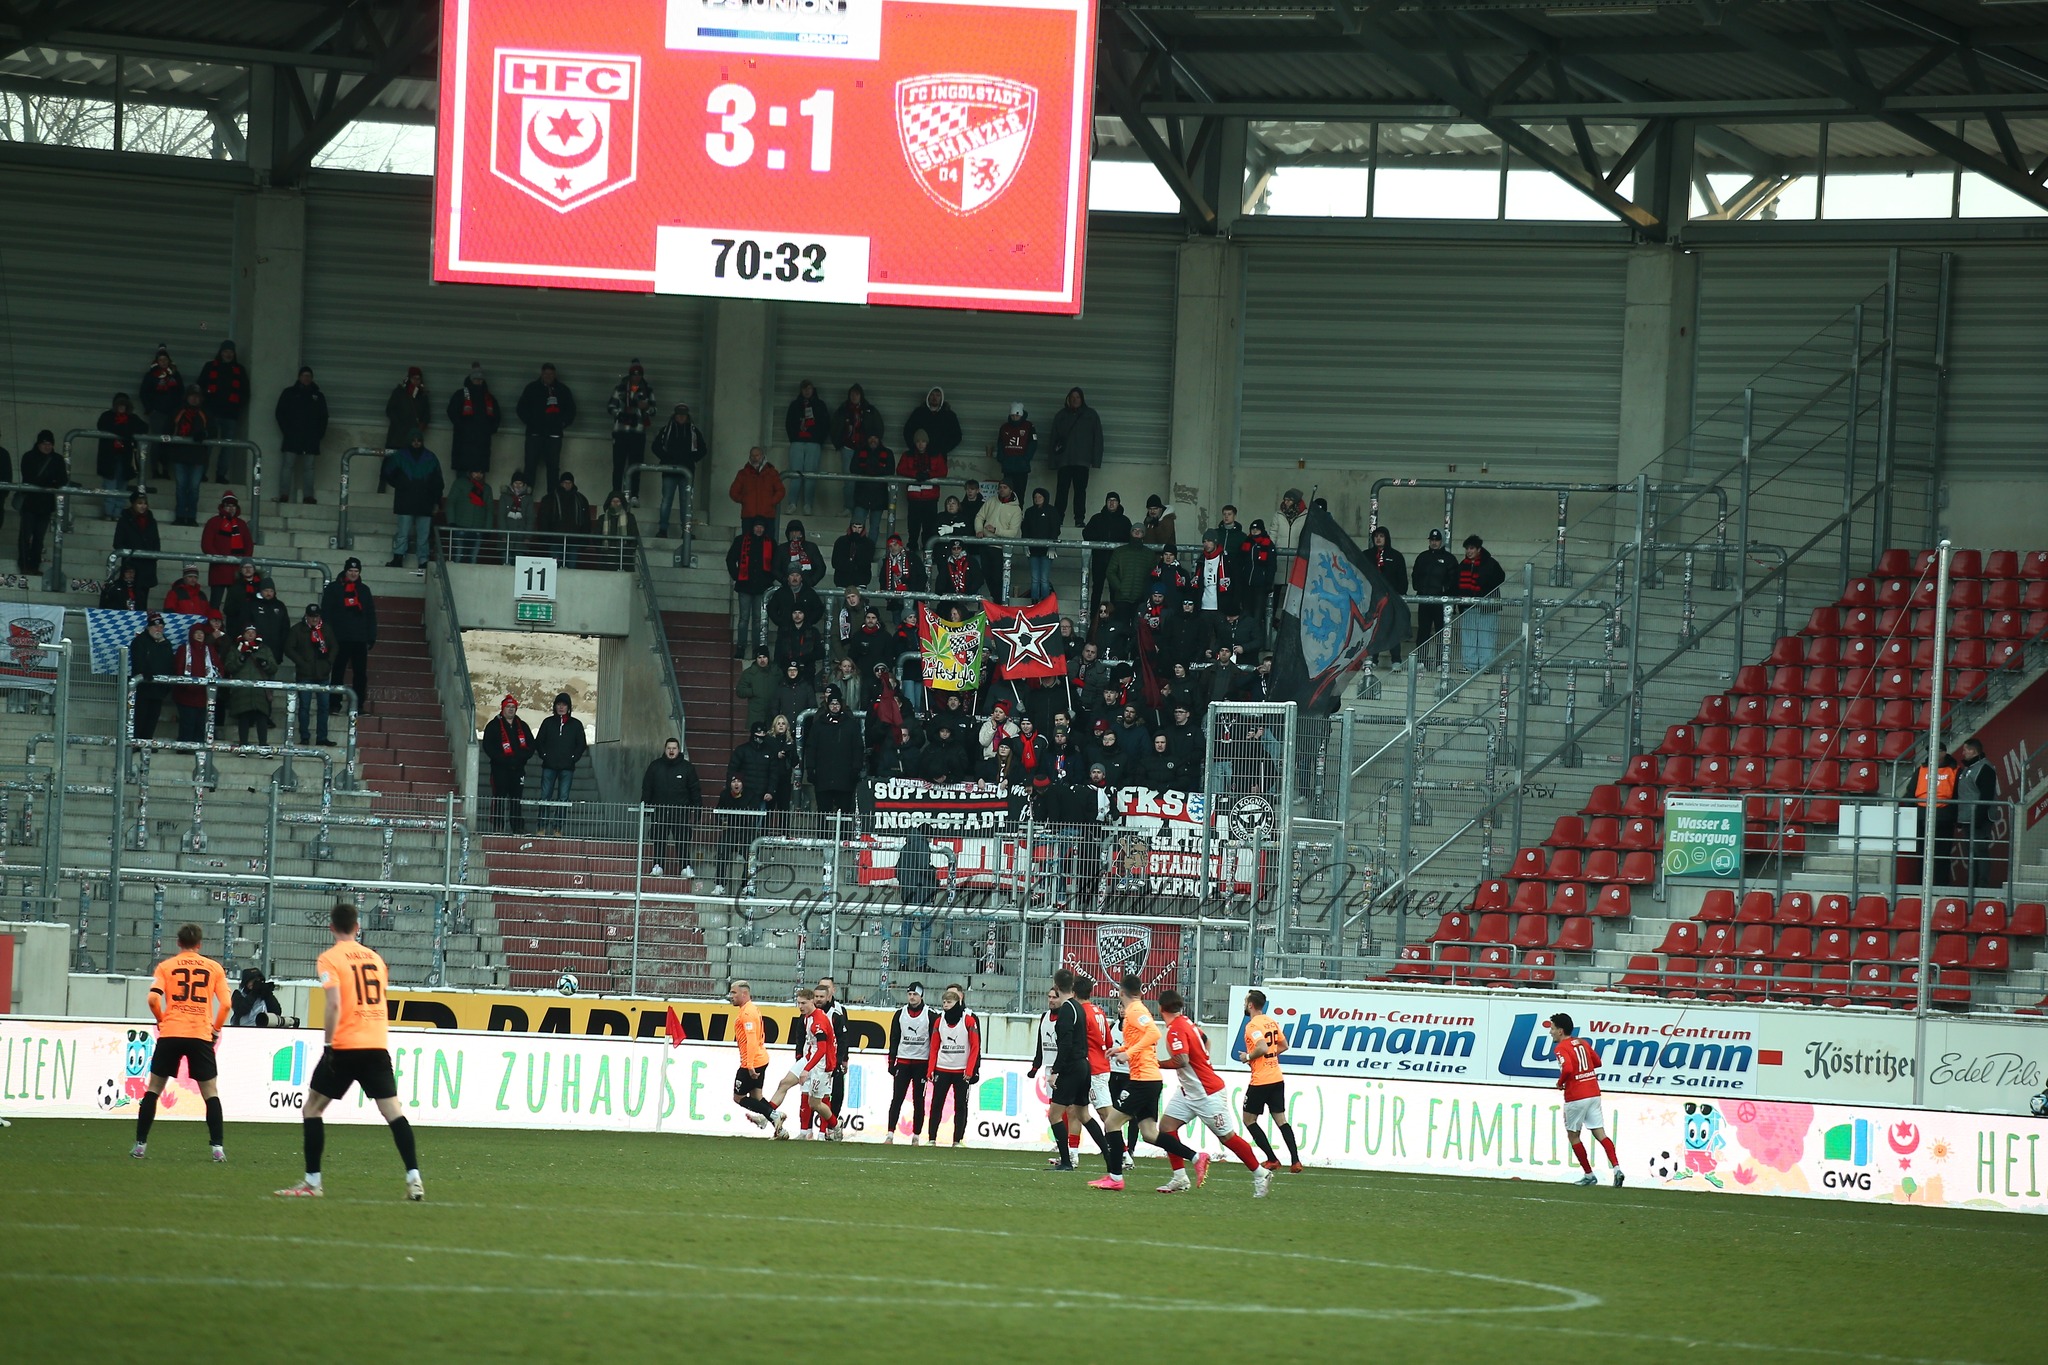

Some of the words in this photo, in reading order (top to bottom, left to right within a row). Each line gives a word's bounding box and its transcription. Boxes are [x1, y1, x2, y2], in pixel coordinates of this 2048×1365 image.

[512, 63, 621, 94] HFC
[931, 84, 1022, 106] INGOLSTADT
[705, 83, 834, 172] 3:1
[914, 113, 1024, 170] SCHANZER
[938, 167, 958, 182] 04
[524, 567, 546, 591] 11
[874, 811, 1008, 830] INGOLSTADT
[1677, 817, 1720, 830] Wasser
[1720, 818, 1731, 831] &
[1669, 830, 1737, 846] Entsorgung
[1103, 940, 1147, 967] SCHANZER
[172, 968, 210, 1003] 32
[351, 964, 381, 1005] 16
[1319, 1007, 1475, 1026] Wohn-Centrum
[1589, 1020, 1751, 1040] Wohn-Centrum
[1323, 1058, 1348, 1068] an
[1357, 1057, 1392, 1070] der
[1397, 1060, 1467, 1074] Saline
[1574, 1045, 1588, 1072] 10
[1929, 1052, 1992, 1085] Edel
[1985, 1052, 2041, 1087] Pils
[495, 1049, 732, 1123] ZUHAUSE.
[1597, 1073, 1620, 1082] an
[1629, 1072, 1665, 1085] der
[1670, 1075, 1744, 1090] Saline
[269, 1091, 303, 1109] GWG
[978, 1121, 1021, 1139] GWG
[1344, 1081, 1406, 1158] FÜR
[1822, 1170, 1872, 1191] GWG
